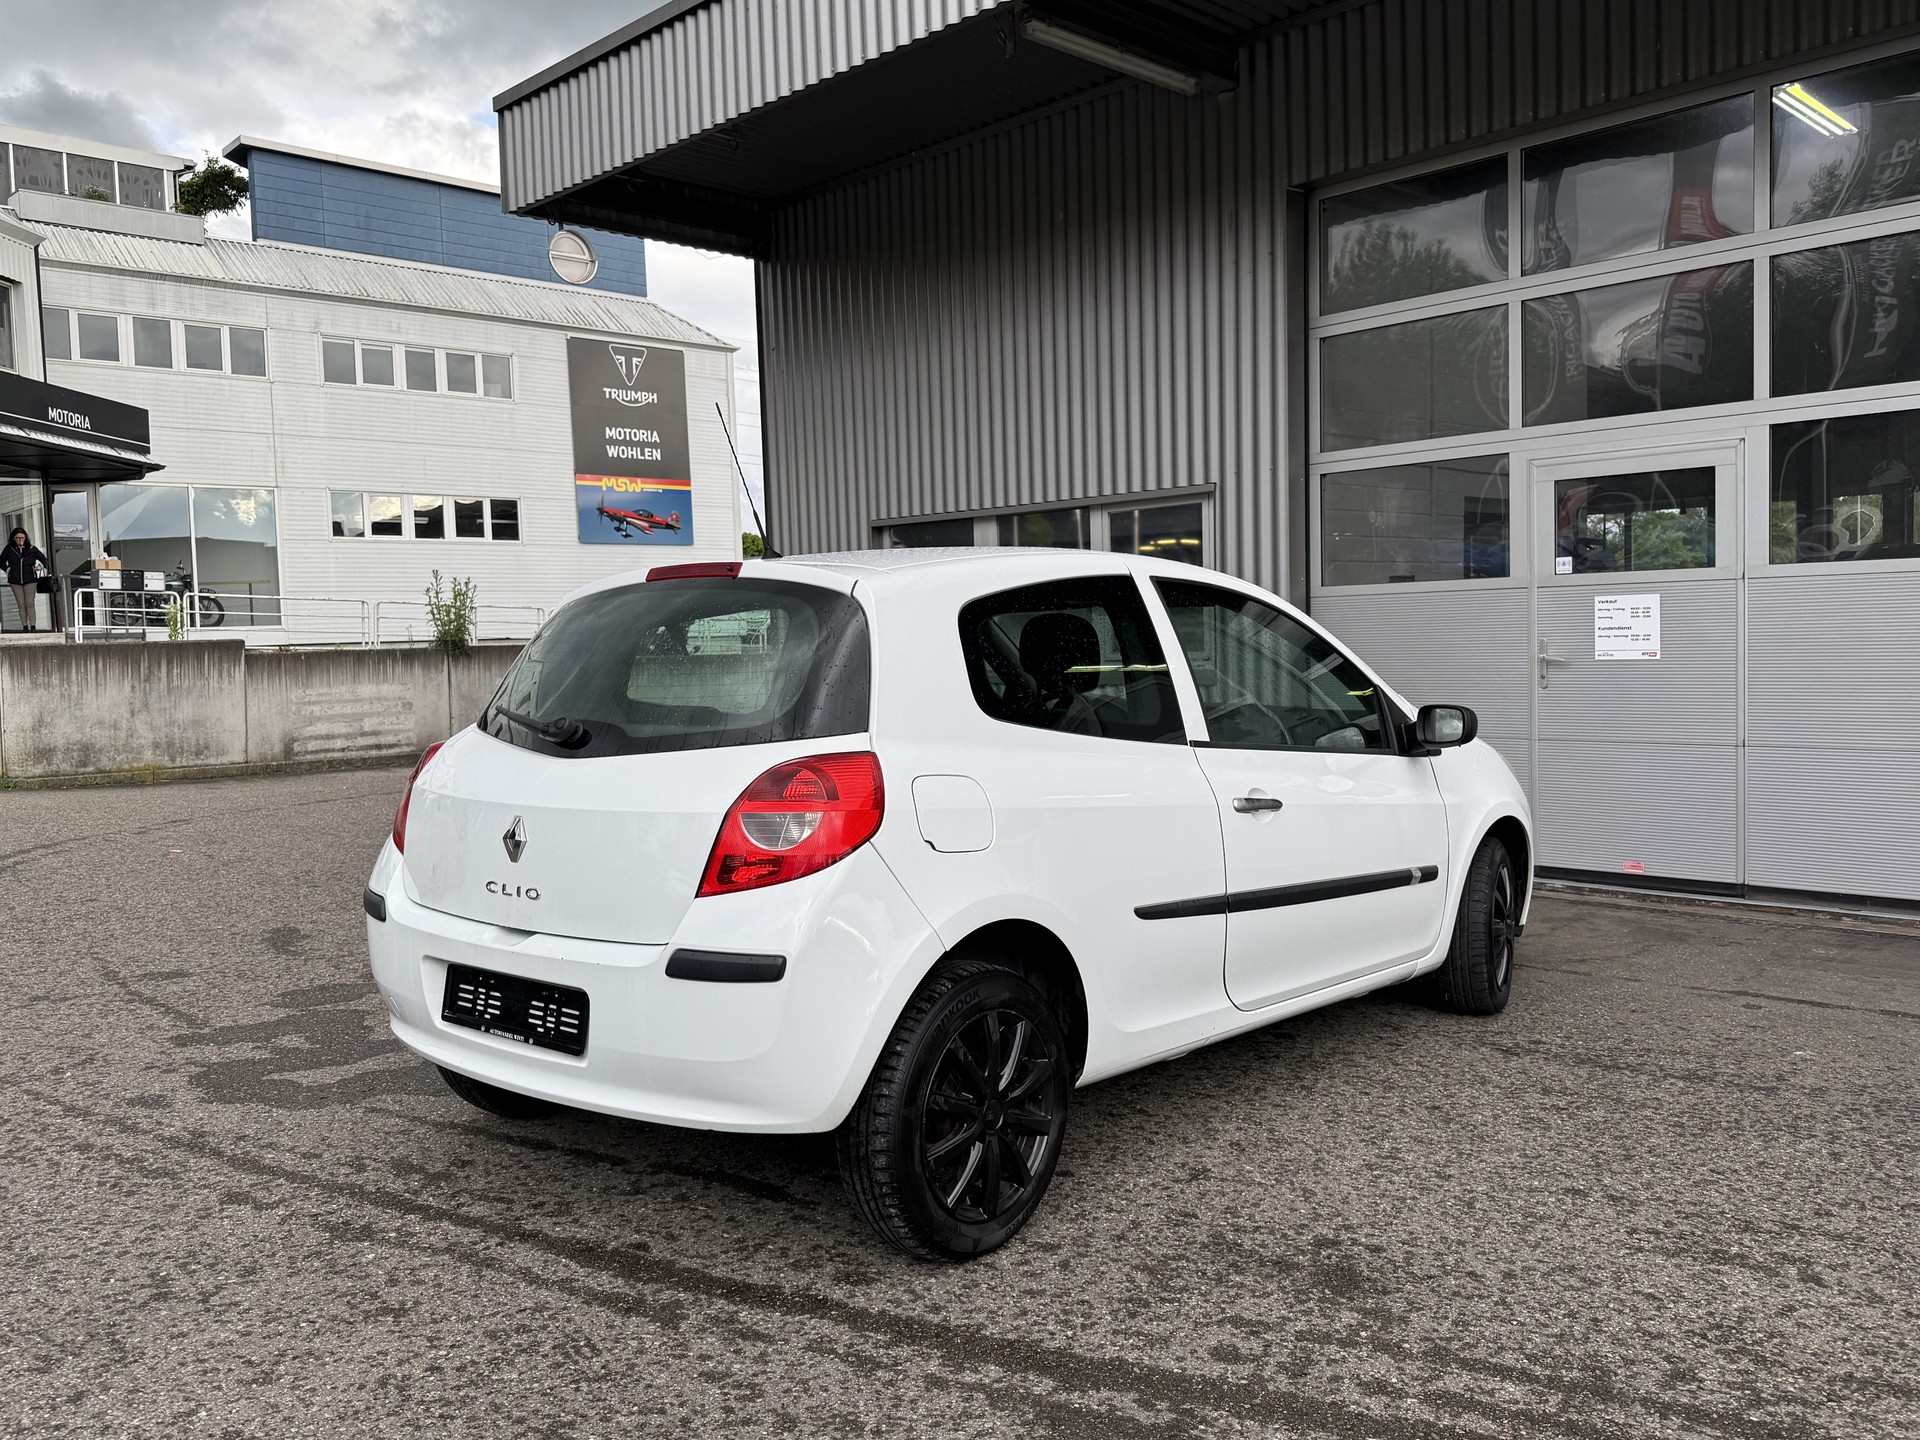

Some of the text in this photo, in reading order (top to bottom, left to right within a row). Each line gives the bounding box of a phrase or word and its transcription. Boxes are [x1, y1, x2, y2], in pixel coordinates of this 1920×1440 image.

[603, 387, 658, 404] TRIUMPH
[48, 406, 91, 430] MOTORIA
[605, 426, 660, 443] MOTORIA
[606, 444, 662, 461] WOHLEN
[602, 477, 642, 493] MSW
[485, 880, 542, 901] CLIO
